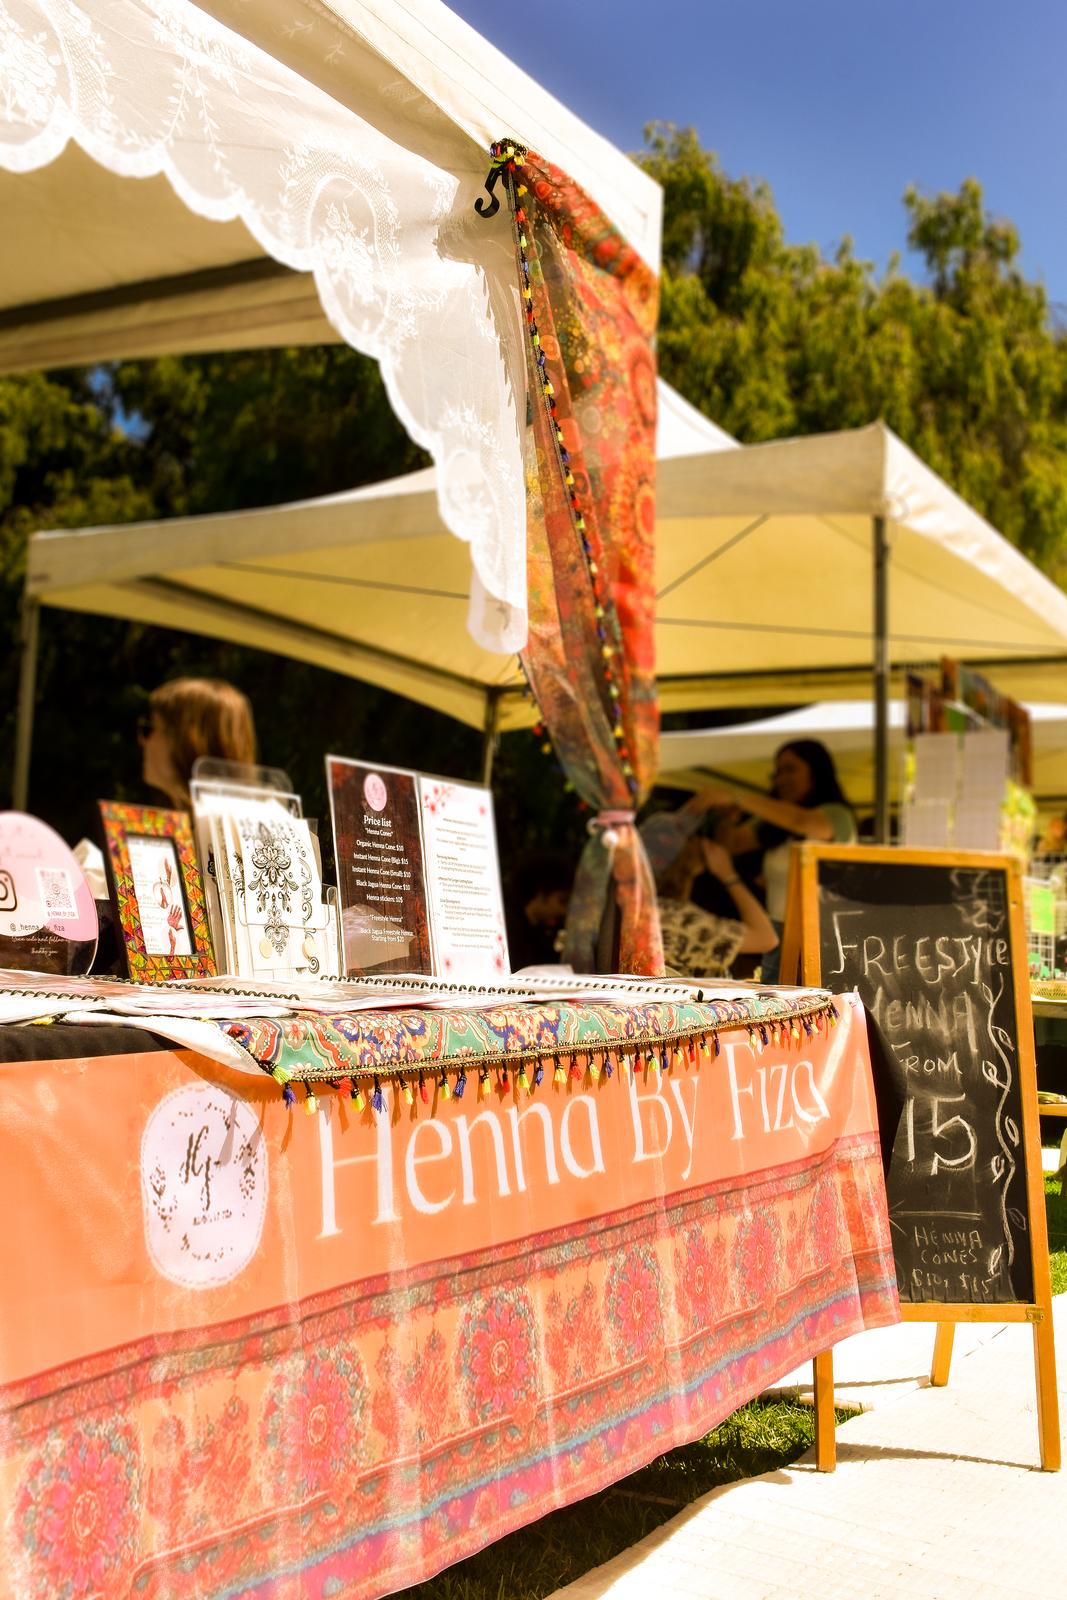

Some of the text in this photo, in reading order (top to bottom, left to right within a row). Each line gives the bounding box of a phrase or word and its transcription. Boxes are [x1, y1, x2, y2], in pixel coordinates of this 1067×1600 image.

[364, 815, 392, 827] Price list
[356, 840, 371, 848] Organic
[354, 852, 367, 860] Instant
[368, 854, 380, 862] Henna
[891, 1041, 963, 1074] FROM
[315, 1084, 606, 1240] Henna
[625, 1052, 700, 1181] By
[723, 1040, 831, 1140] Fiza
[906, 1092, 977, 1176] 15
[914, 1226, 983, 1250] HENNA
[921, 1249, 977, 1265] CONES
